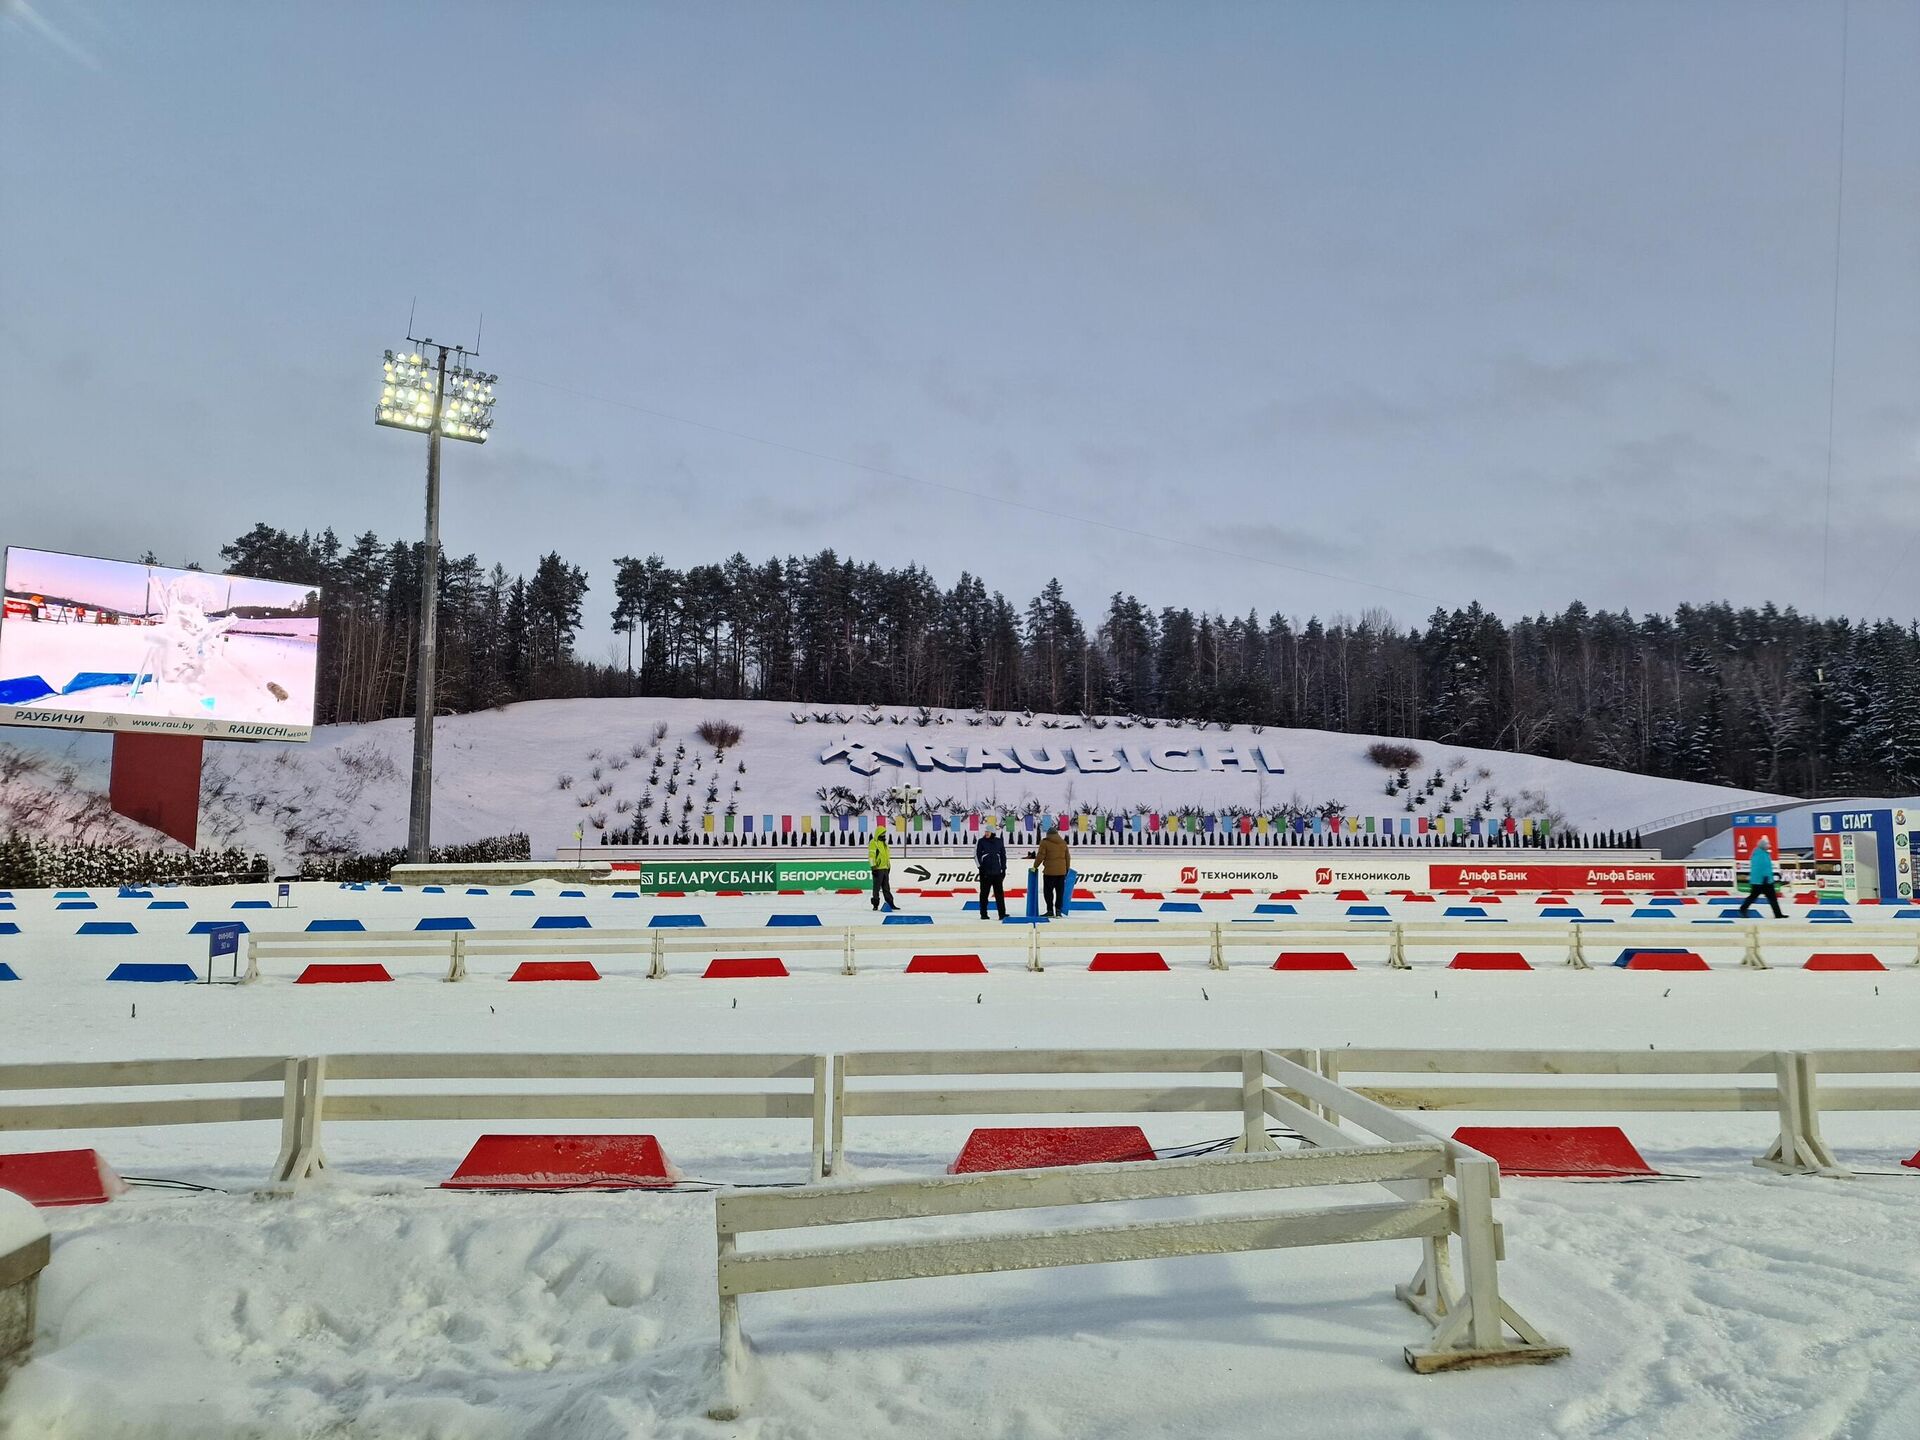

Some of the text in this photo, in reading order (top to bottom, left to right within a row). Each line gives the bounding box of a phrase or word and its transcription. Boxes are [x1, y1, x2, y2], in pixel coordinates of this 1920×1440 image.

[14, 711, 85, 724] РАУБИЧИ
[132, 720, 194, 731] www.rau.by
[228, 724, 288, 737] RAUBICHI
[905, 740, 1285, 774] RAUBICHI
[1842, 813, 1873, 829] СТАРТ
[658, 870, 774, 885] БЕЛАРУСБАНК
[779, 870, 873, 882] БЕЛОРУСНЕФТ
[1201, 871, 1279, 880] ТЕХНОНИКОЛЬ
[1335, 872, 1411, 881] ТЕХНОНИКОЛЬ
[1459, 869, 1528, 883] Альфа Банк
[1587, 870, 1655, 883] Альфа Банк
